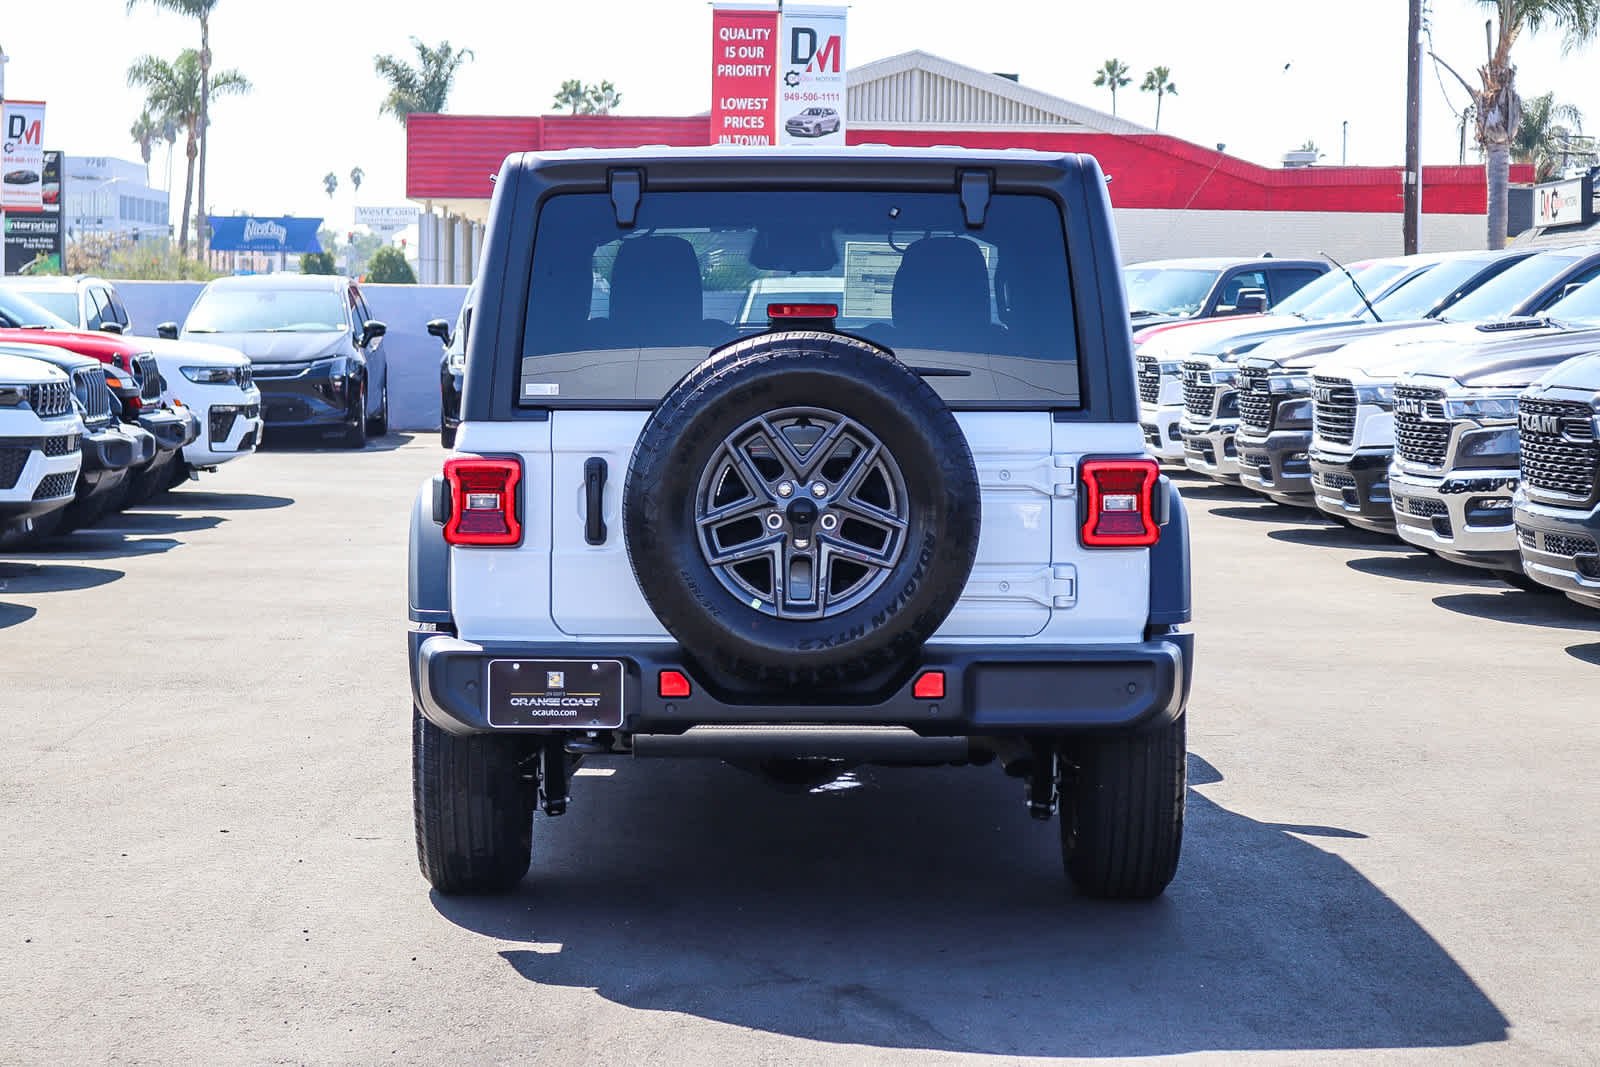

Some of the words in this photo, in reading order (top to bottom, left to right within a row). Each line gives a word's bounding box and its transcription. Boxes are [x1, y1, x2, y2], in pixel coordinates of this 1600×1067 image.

[719, 28, 771, 41] QUALITY
[725, 46, 736, 58] IS
[738, 46, 765, 59] OUR
[791, 27, 841, 73] DM
[717, 64, 772, 77] PRIORITY
[720, 97, 768, 110] LOWEST
[724, 116, 765, 129] PRICES
[719, 134, 732, 146] IN
[734, 134, 770, 146] TOWN
[360, 207, 384, 217] West
[386, 207, 417, 217] Coast
[1520, 413, 1559, 434] RAM
[510, 697, 561, 707] ORANGE
[561, 697, 600, 707] COAST
[532, 709, 578, 717] ocauto.com
